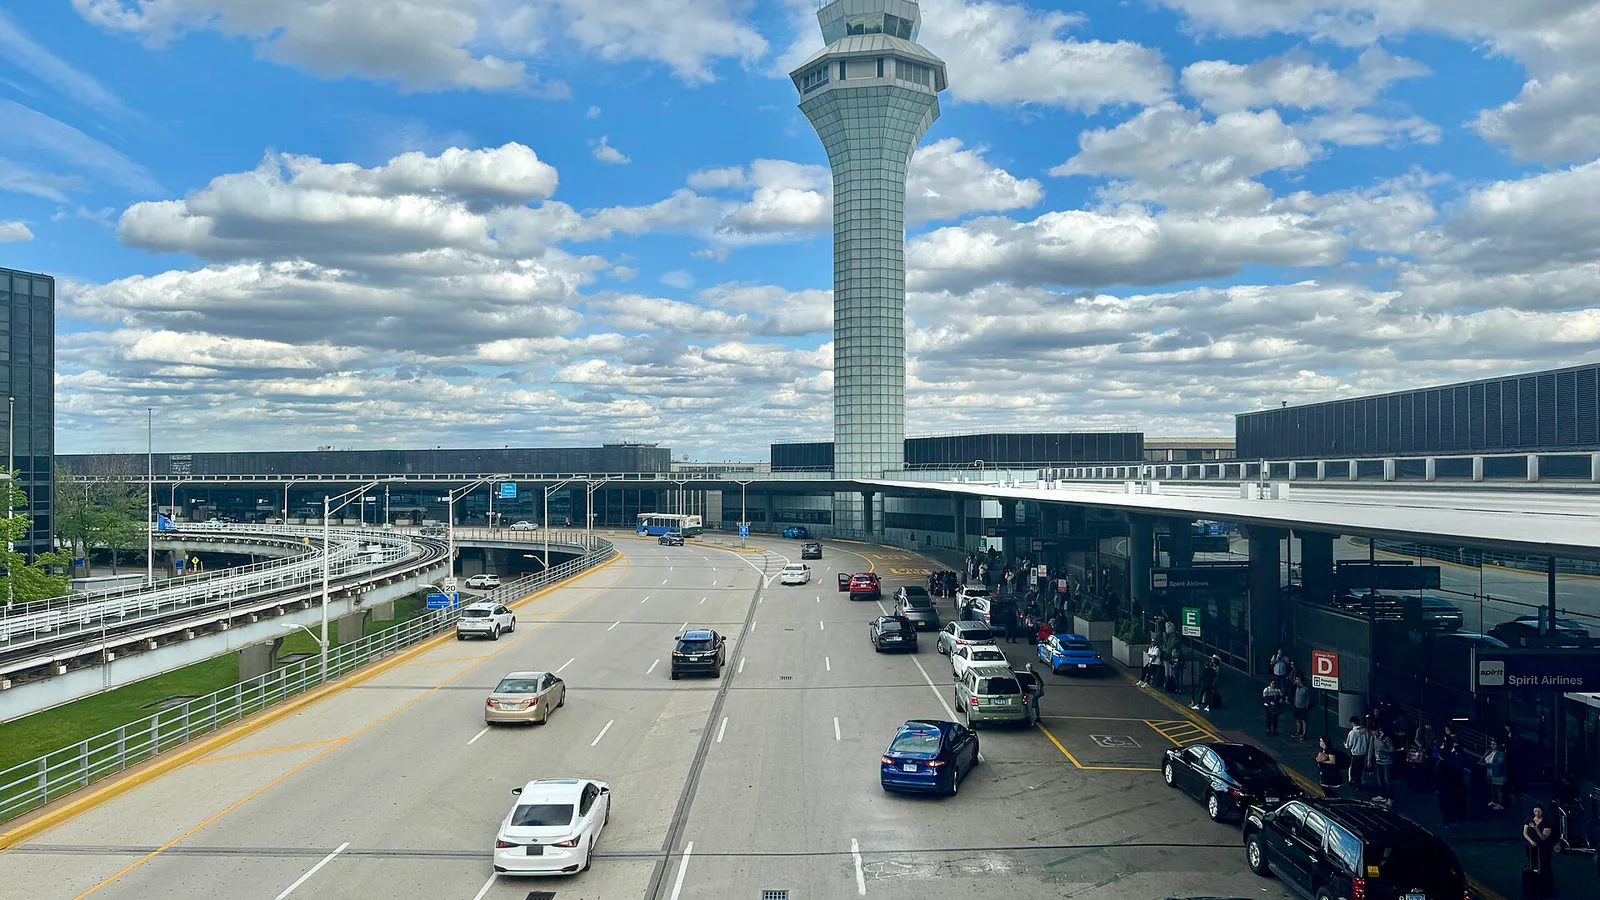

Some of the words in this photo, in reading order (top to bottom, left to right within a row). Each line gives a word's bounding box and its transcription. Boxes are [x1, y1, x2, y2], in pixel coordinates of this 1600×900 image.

[1186, 612, 1196, 625] E
[1317, 657, 1333, 674] D
[1508, 675, 1539, 687] Spirit
[1541, 675, 1583, 685] Airlines
